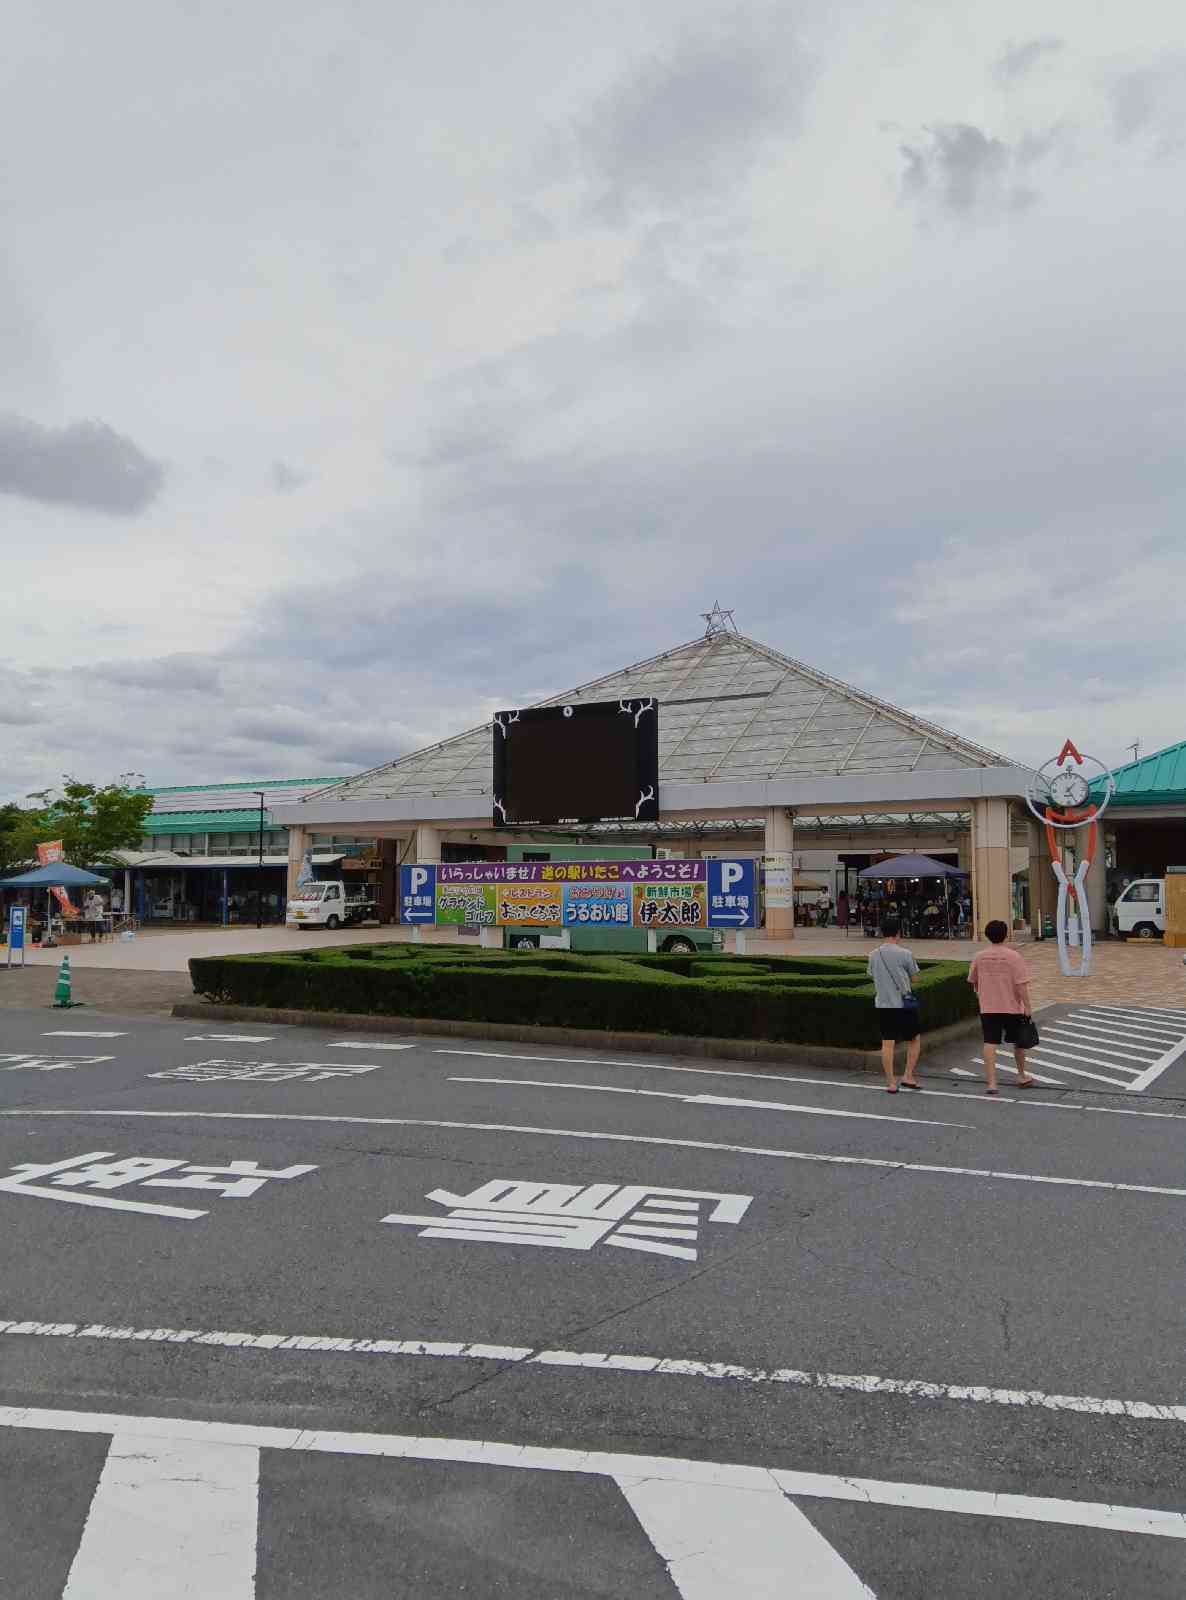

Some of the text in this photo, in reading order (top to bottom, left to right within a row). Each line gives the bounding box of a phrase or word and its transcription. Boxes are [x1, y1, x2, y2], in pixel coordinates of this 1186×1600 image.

[410, 867, 428, 895] P
[721, 862, 744, 893] P
[646, 886, 692, 899] 新鮮市場
[403, 896, 432, 907] 駐車場
[712, 895, 749, 908] 駐車場
[464, 910, 496, 923] ゴルフ
[566, 903, 629, 922] うるおい館
[640, 901, 701, 924] 伊太郎
